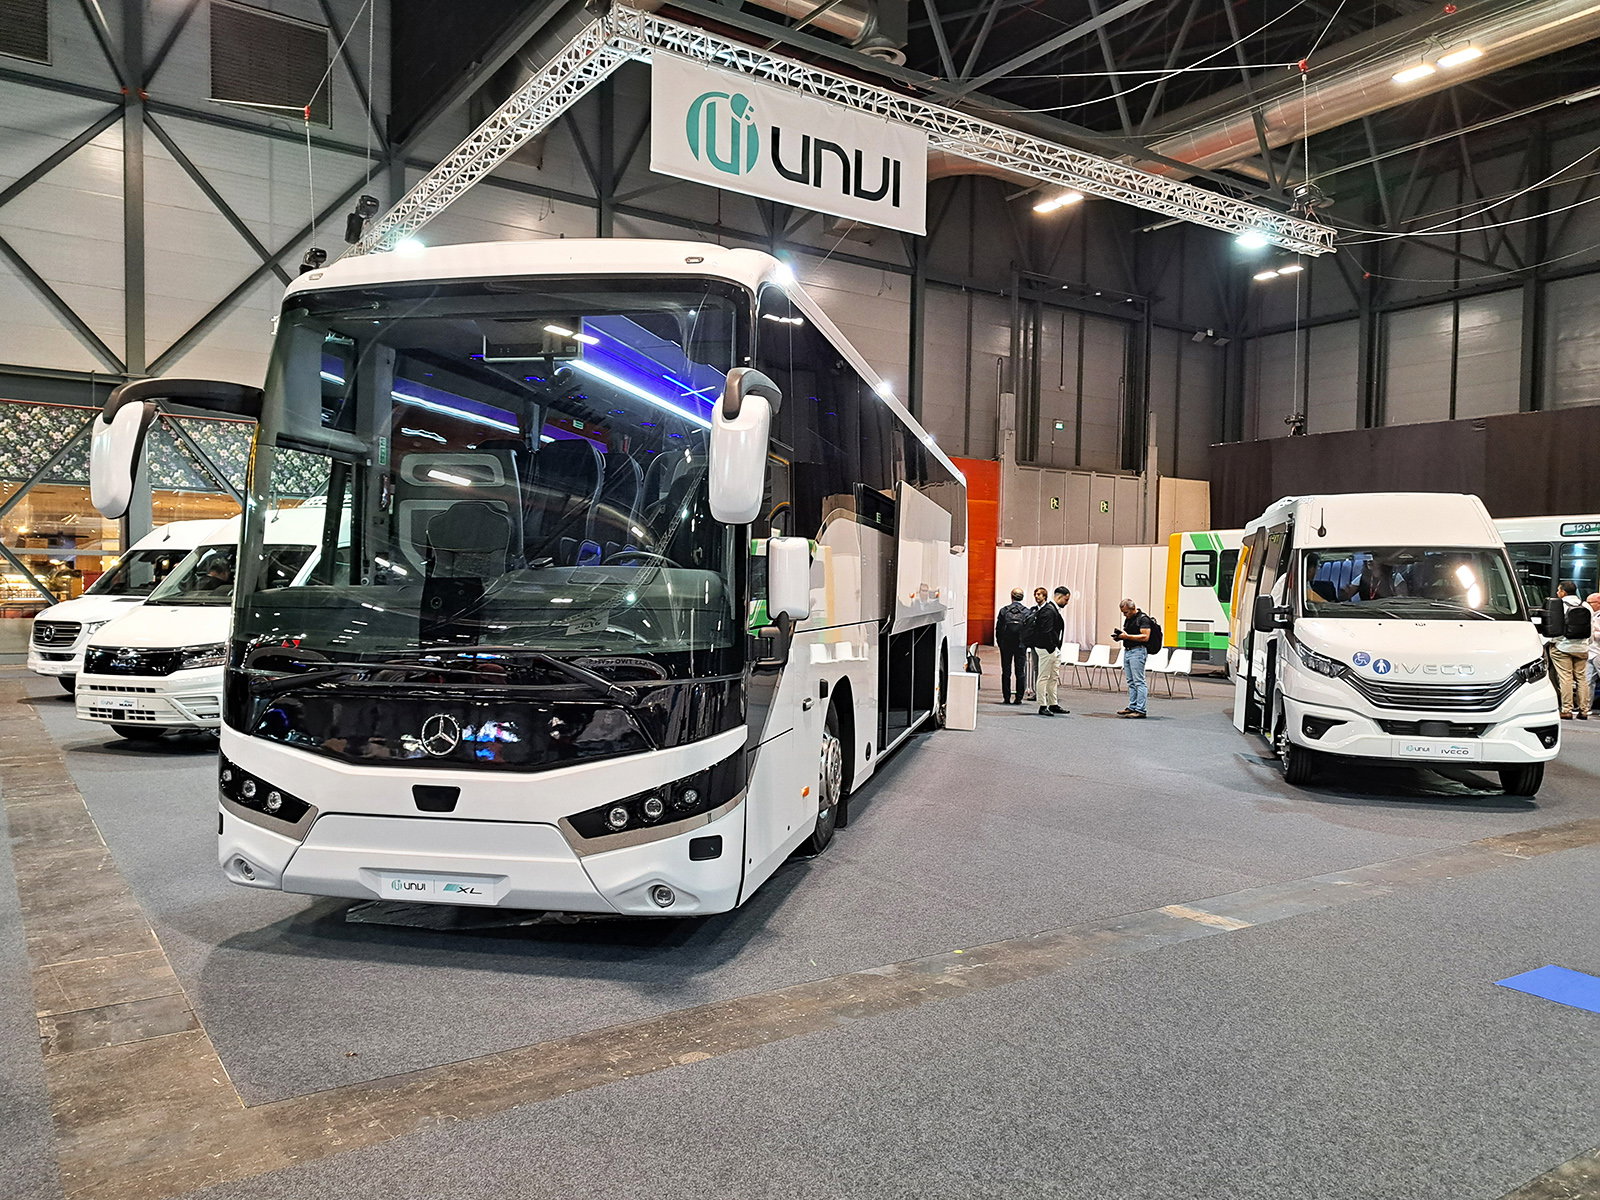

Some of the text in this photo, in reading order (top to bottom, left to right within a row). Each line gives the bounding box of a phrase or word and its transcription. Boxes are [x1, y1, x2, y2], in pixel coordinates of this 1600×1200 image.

[1574, 524, 1591, 533] 129
[1393, 662, 1475, 675] IVECO
[456, 886, 482, 895] XL
